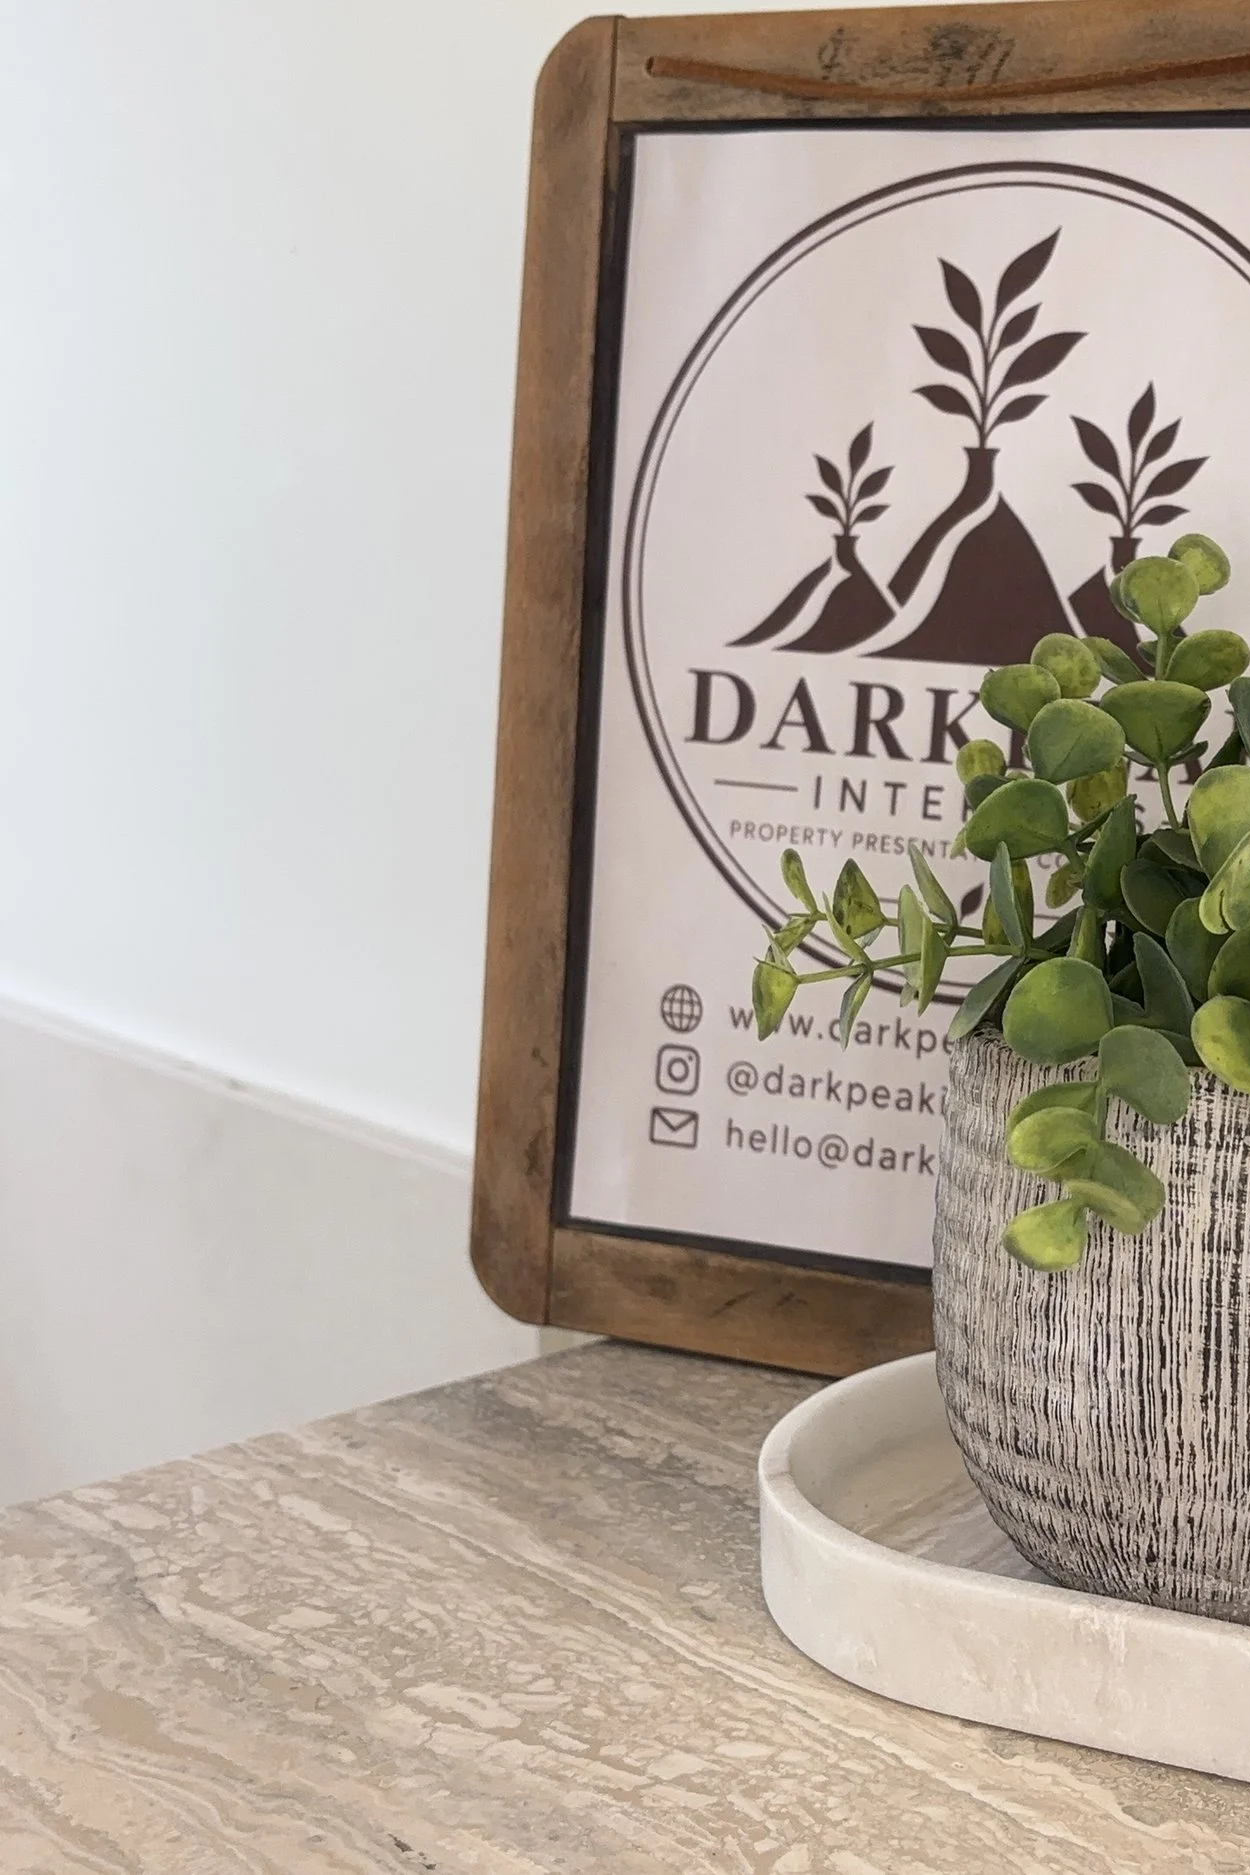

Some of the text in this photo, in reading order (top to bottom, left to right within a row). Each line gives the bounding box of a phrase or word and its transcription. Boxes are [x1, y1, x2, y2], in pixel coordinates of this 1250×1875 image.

[730, 820, 843, 848] PROPERTY
[726, 1061, 948, 1116] @darkpeaki
[725, 1117, 937, 1176] hello@dark
